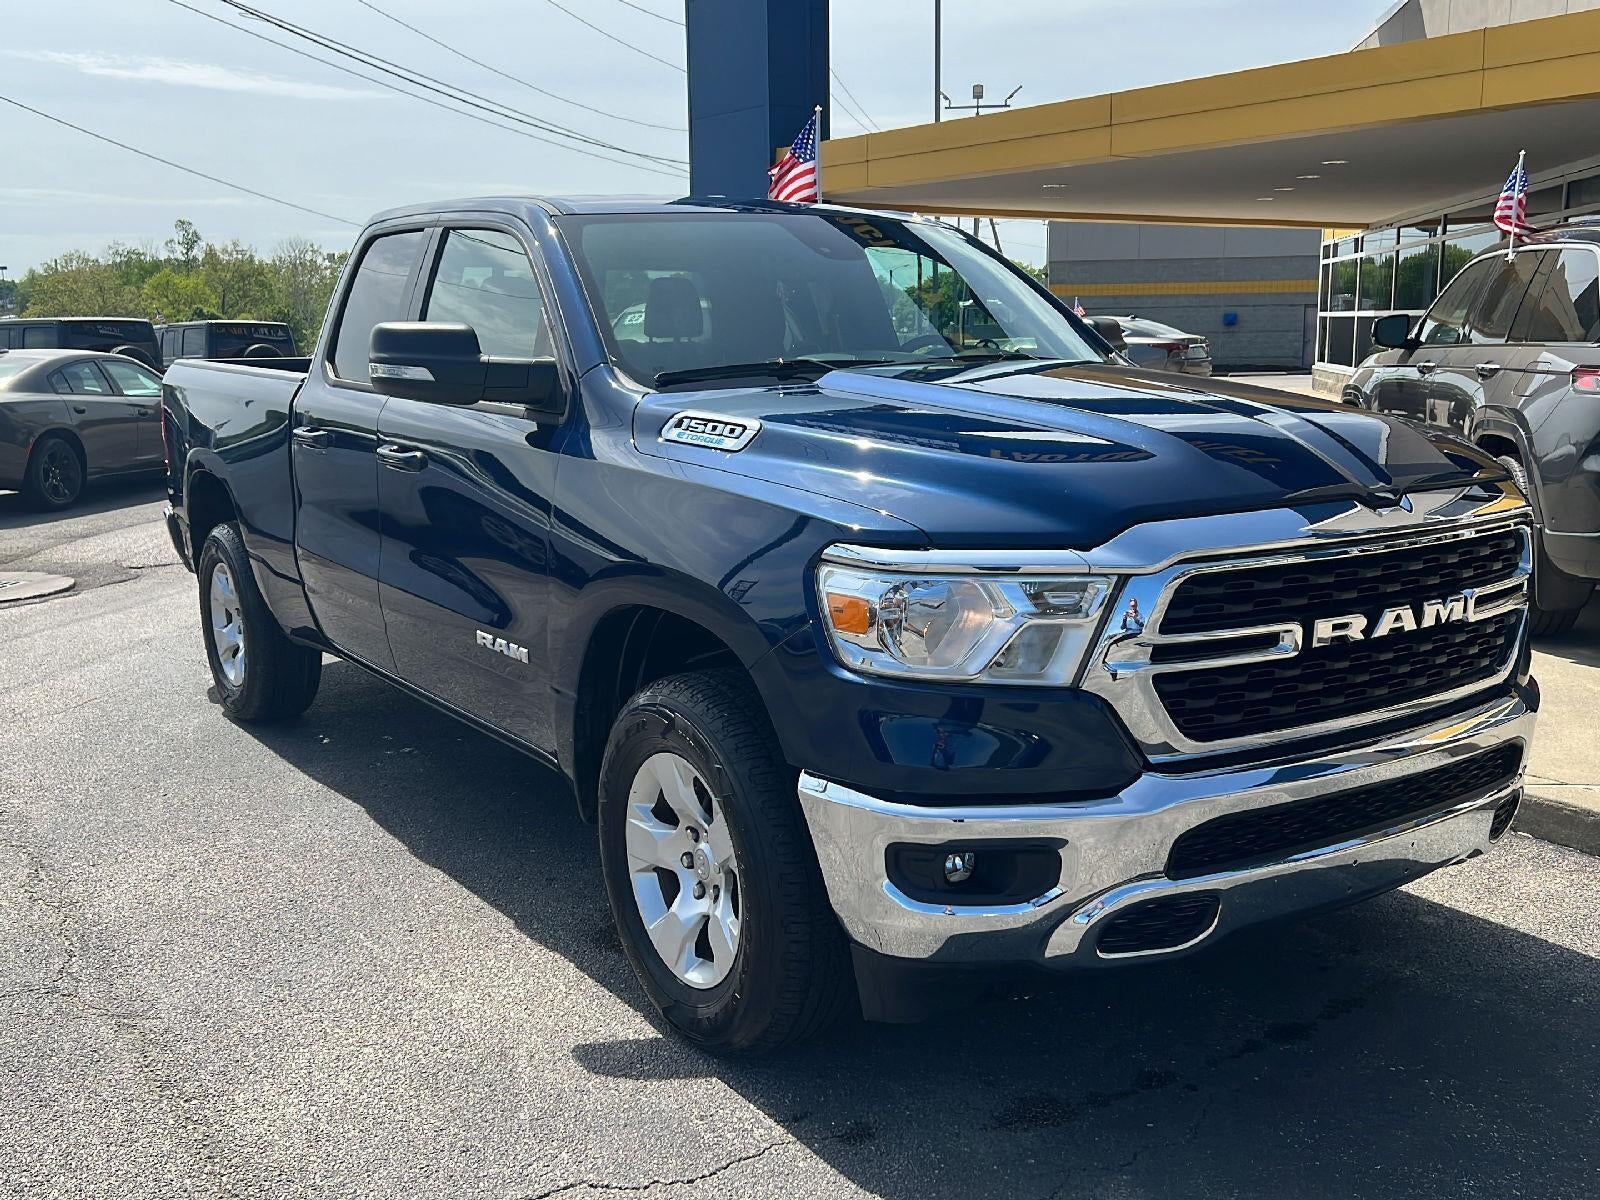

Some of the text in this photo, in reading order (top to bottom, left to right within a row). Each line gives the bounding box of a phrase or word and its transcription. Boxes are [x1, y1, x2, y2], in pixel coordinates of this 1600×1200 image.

[681, 418, 743, 438] 1500
[1312, 595, 1464, 648] RAM
[476, 630, 529, 664] RAM
